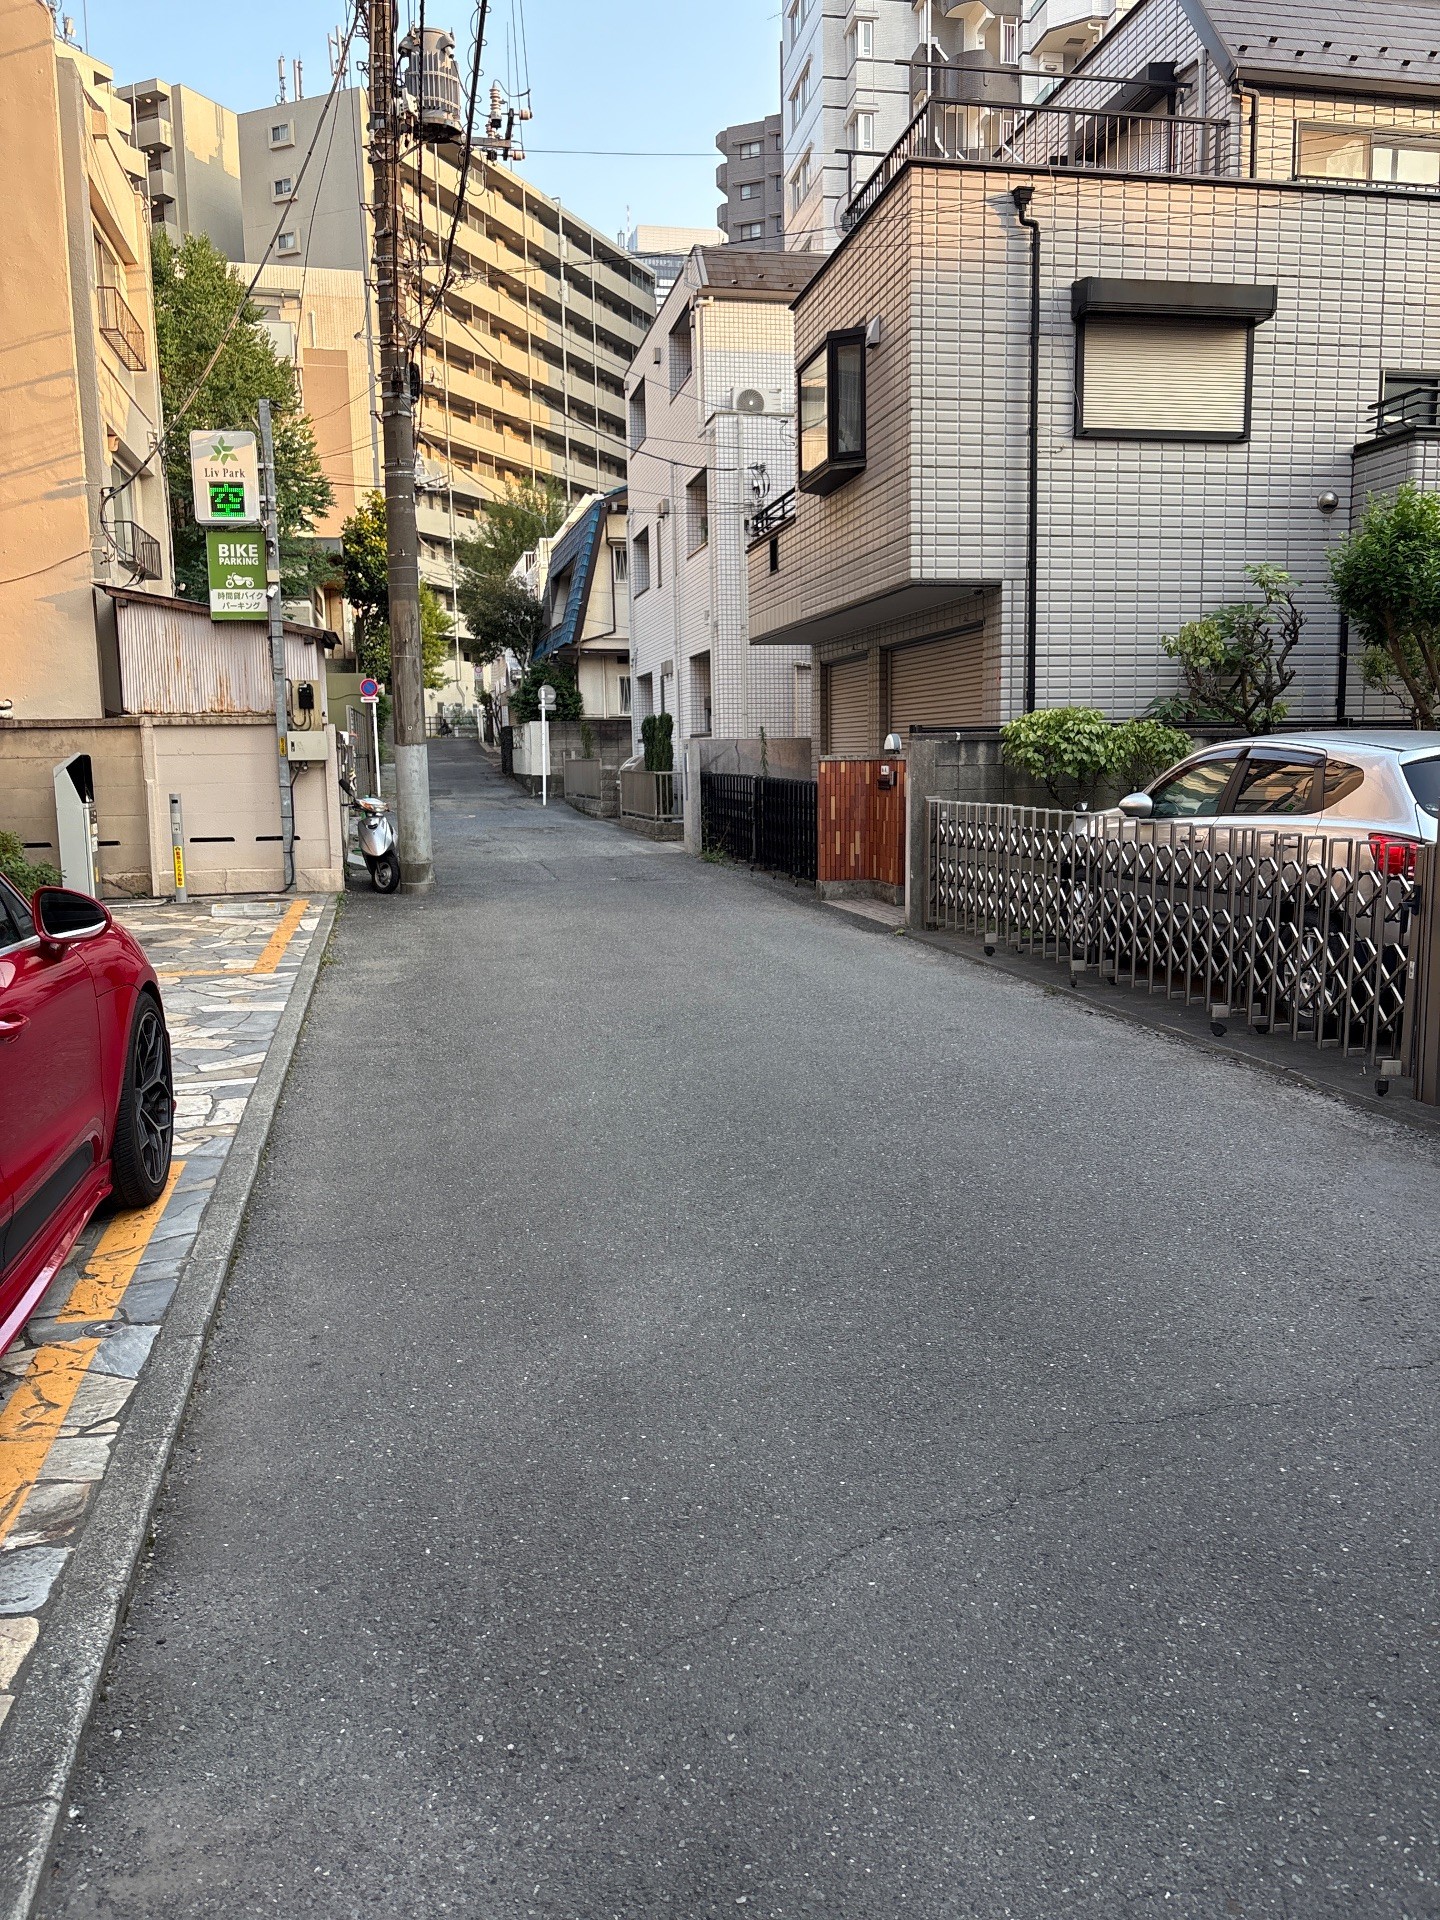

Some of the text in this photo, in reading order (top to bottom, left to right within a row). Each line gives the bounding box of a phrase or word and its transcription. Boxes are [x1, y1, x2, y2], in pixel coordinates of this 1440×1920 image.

[204, 467, 246, 478] Liv Park
[209, 483, 246, 518] 空
[218, 543, 259, 557] BIKE
[218, 557, 259, 566] PARKING
[217, 591, 264, 600] 時間貸バイク
[222, 601, 261, 610] パーキング
